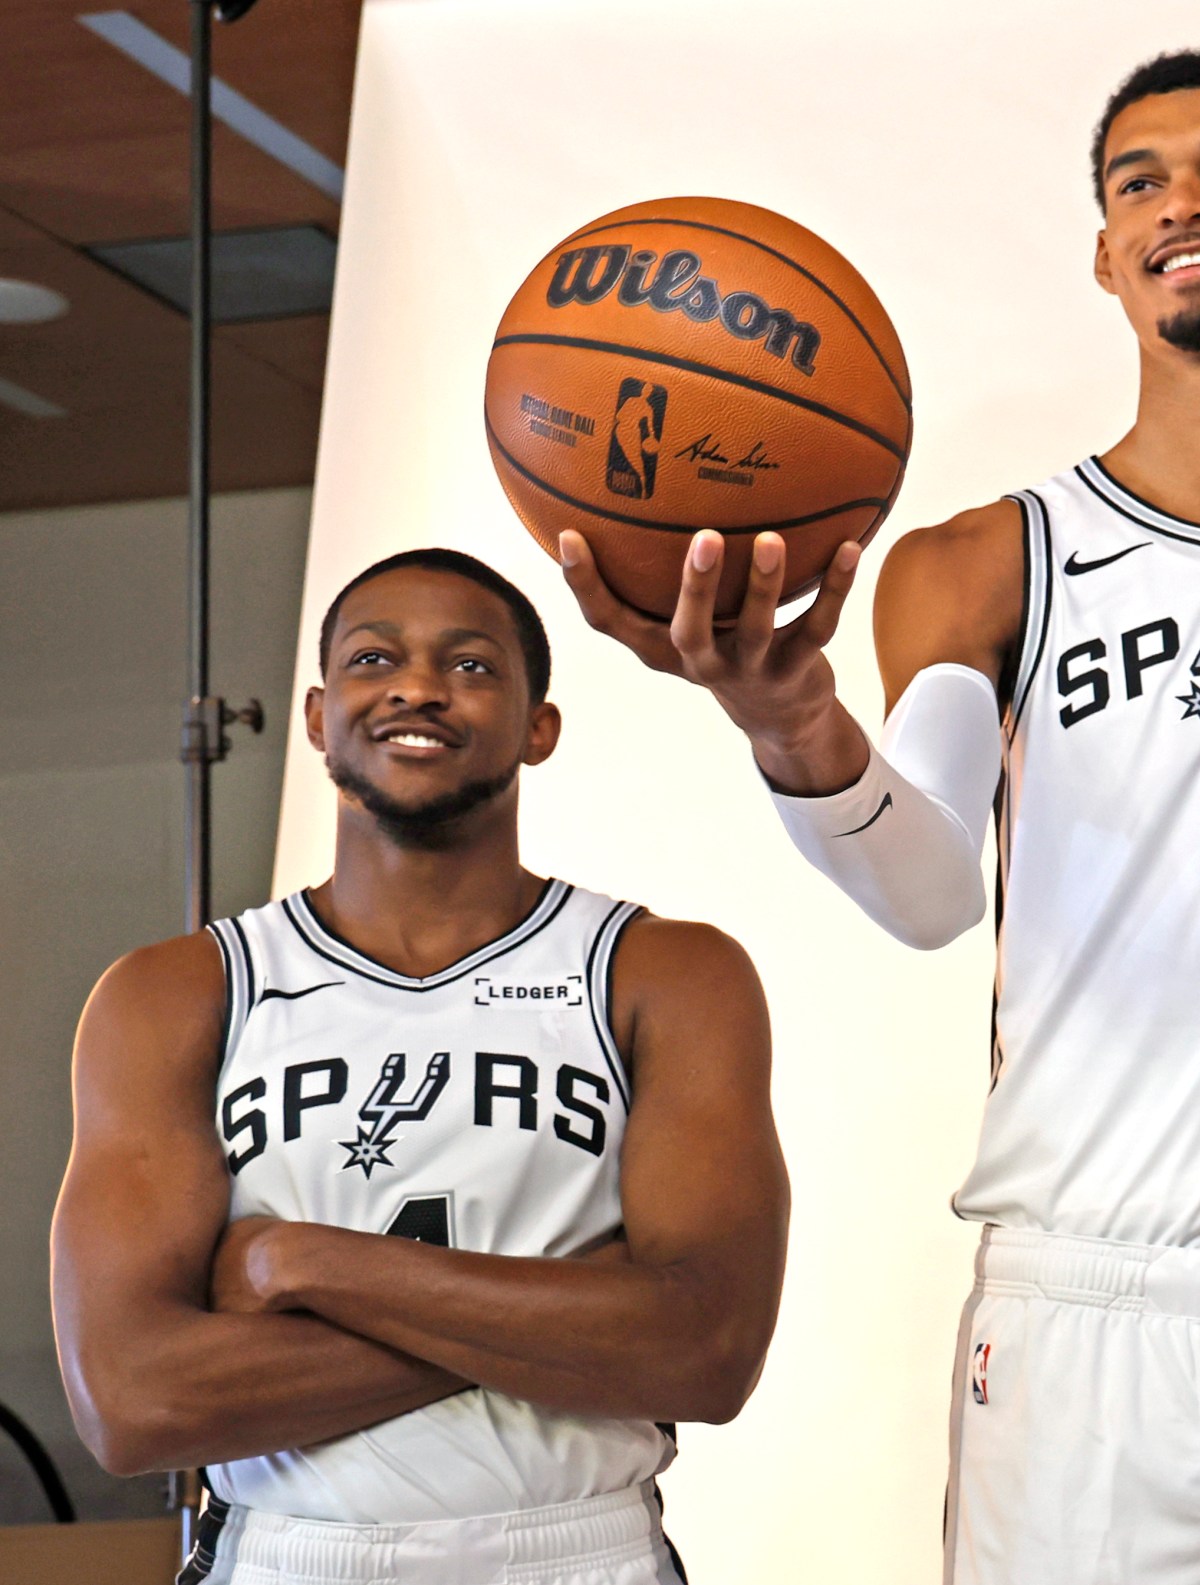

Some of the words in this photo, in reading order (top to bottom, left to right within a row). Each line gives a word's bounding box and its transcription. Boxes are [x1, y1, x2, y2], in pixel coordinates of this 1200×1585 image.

[546, 244, 821, 378] Wilson
[574, 413, 596, 437] BALL
[489, 985, 569, 999] LEDGER
[222, 1052, 610, 1178] SPURS
